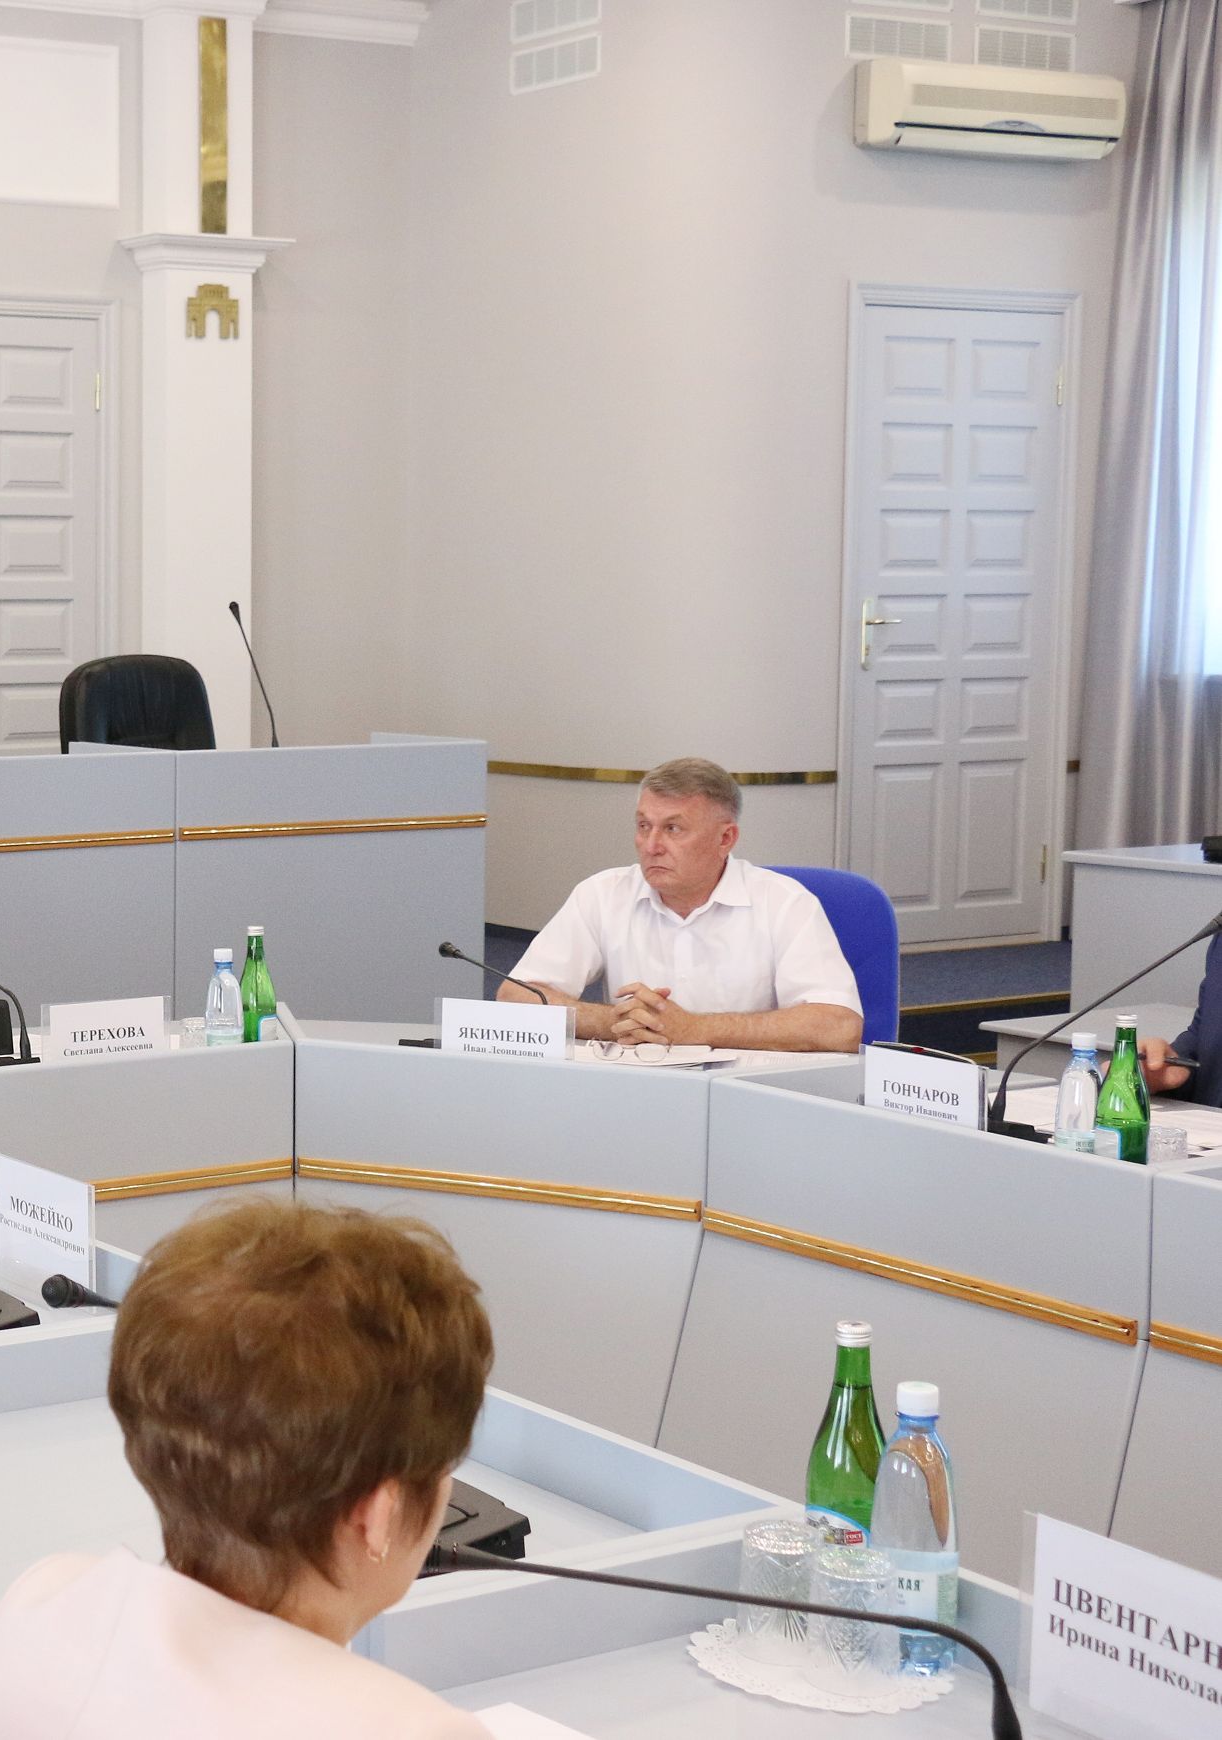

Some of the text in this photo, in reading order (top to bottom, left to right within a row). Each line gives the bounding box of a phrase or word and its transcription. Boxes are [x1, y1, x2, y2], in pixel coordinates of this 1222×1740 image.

[70, 1025, 146, 1043] ТЕРЕХОВА
[458, 1026, 550, 1046] ЯКИМЕНКО
[63, 1043, 154, 1057] Светлана Алексеевна
[463, 1043, 545, 1058] Иван Леонидович
[882, 1079, 960, 1107] ГОНЧАРОВ
[883, 1099, 958, 1121] Виктор Иванович
[9, 1195, 74, 1233] МОЖЕЙКО
[1048, 1613, 1222, 1706] Ирина Никола
